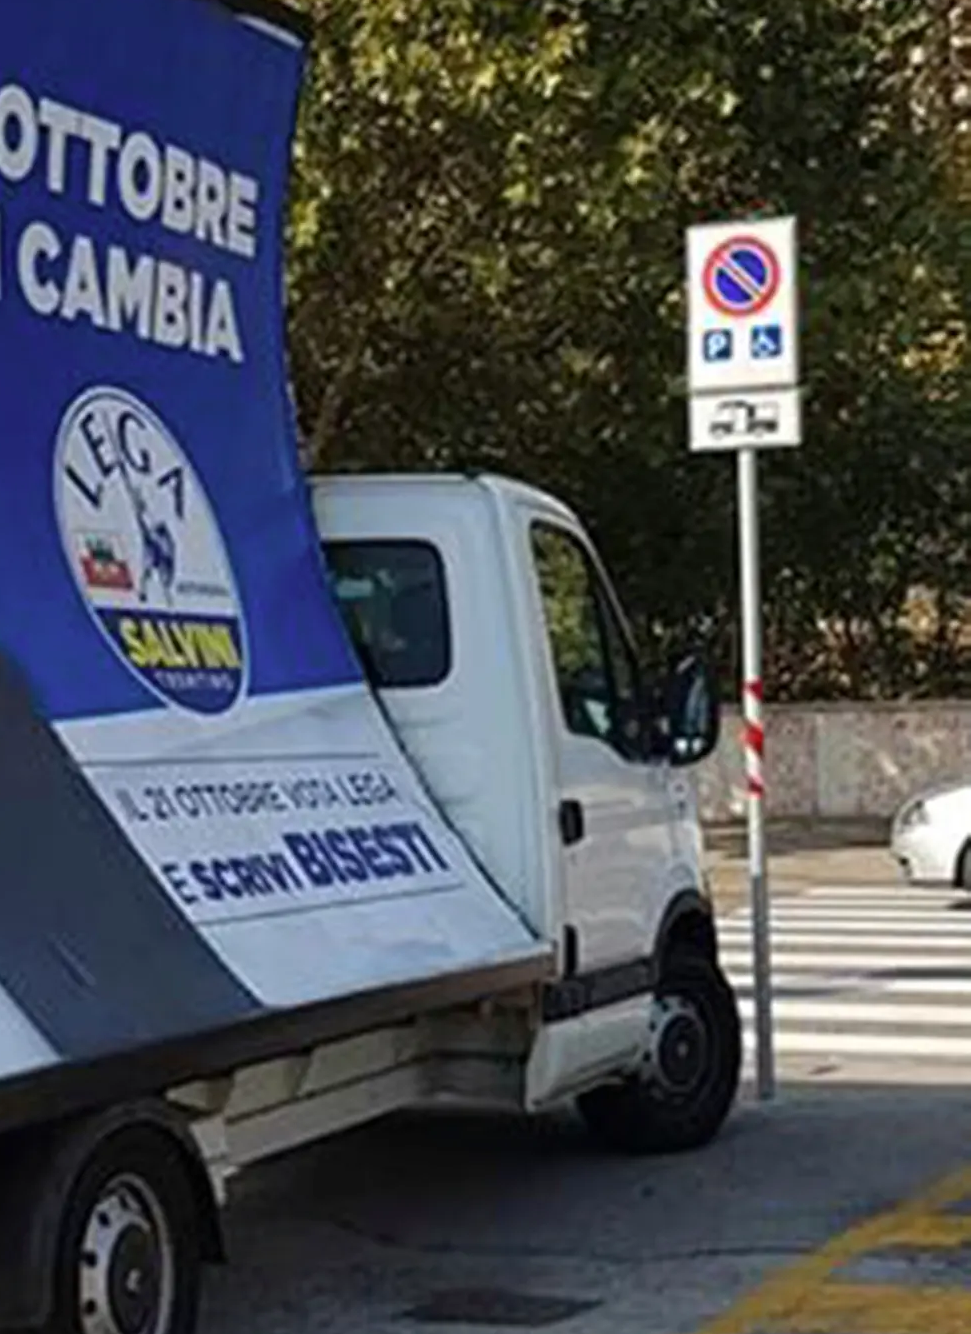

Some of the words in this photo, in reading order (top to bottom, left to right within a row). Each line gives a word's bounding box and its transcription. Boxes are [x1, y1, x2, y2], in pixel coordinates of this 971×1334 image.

[17, 220, 244, 363] CAMBIA
[119, 618, 242, 668] SALVINI
[143, 786, 174, 820] 21
[175, 780, 286, 816] OTTOBRE
[278, 774, 339, 812] VOTA
[337, 770, 397, 806] LEGA
[163, 864, 198, 905] E
[190, 851, 304, 901] SCRIVI
[282, 821, 450, 887] BISESTI
